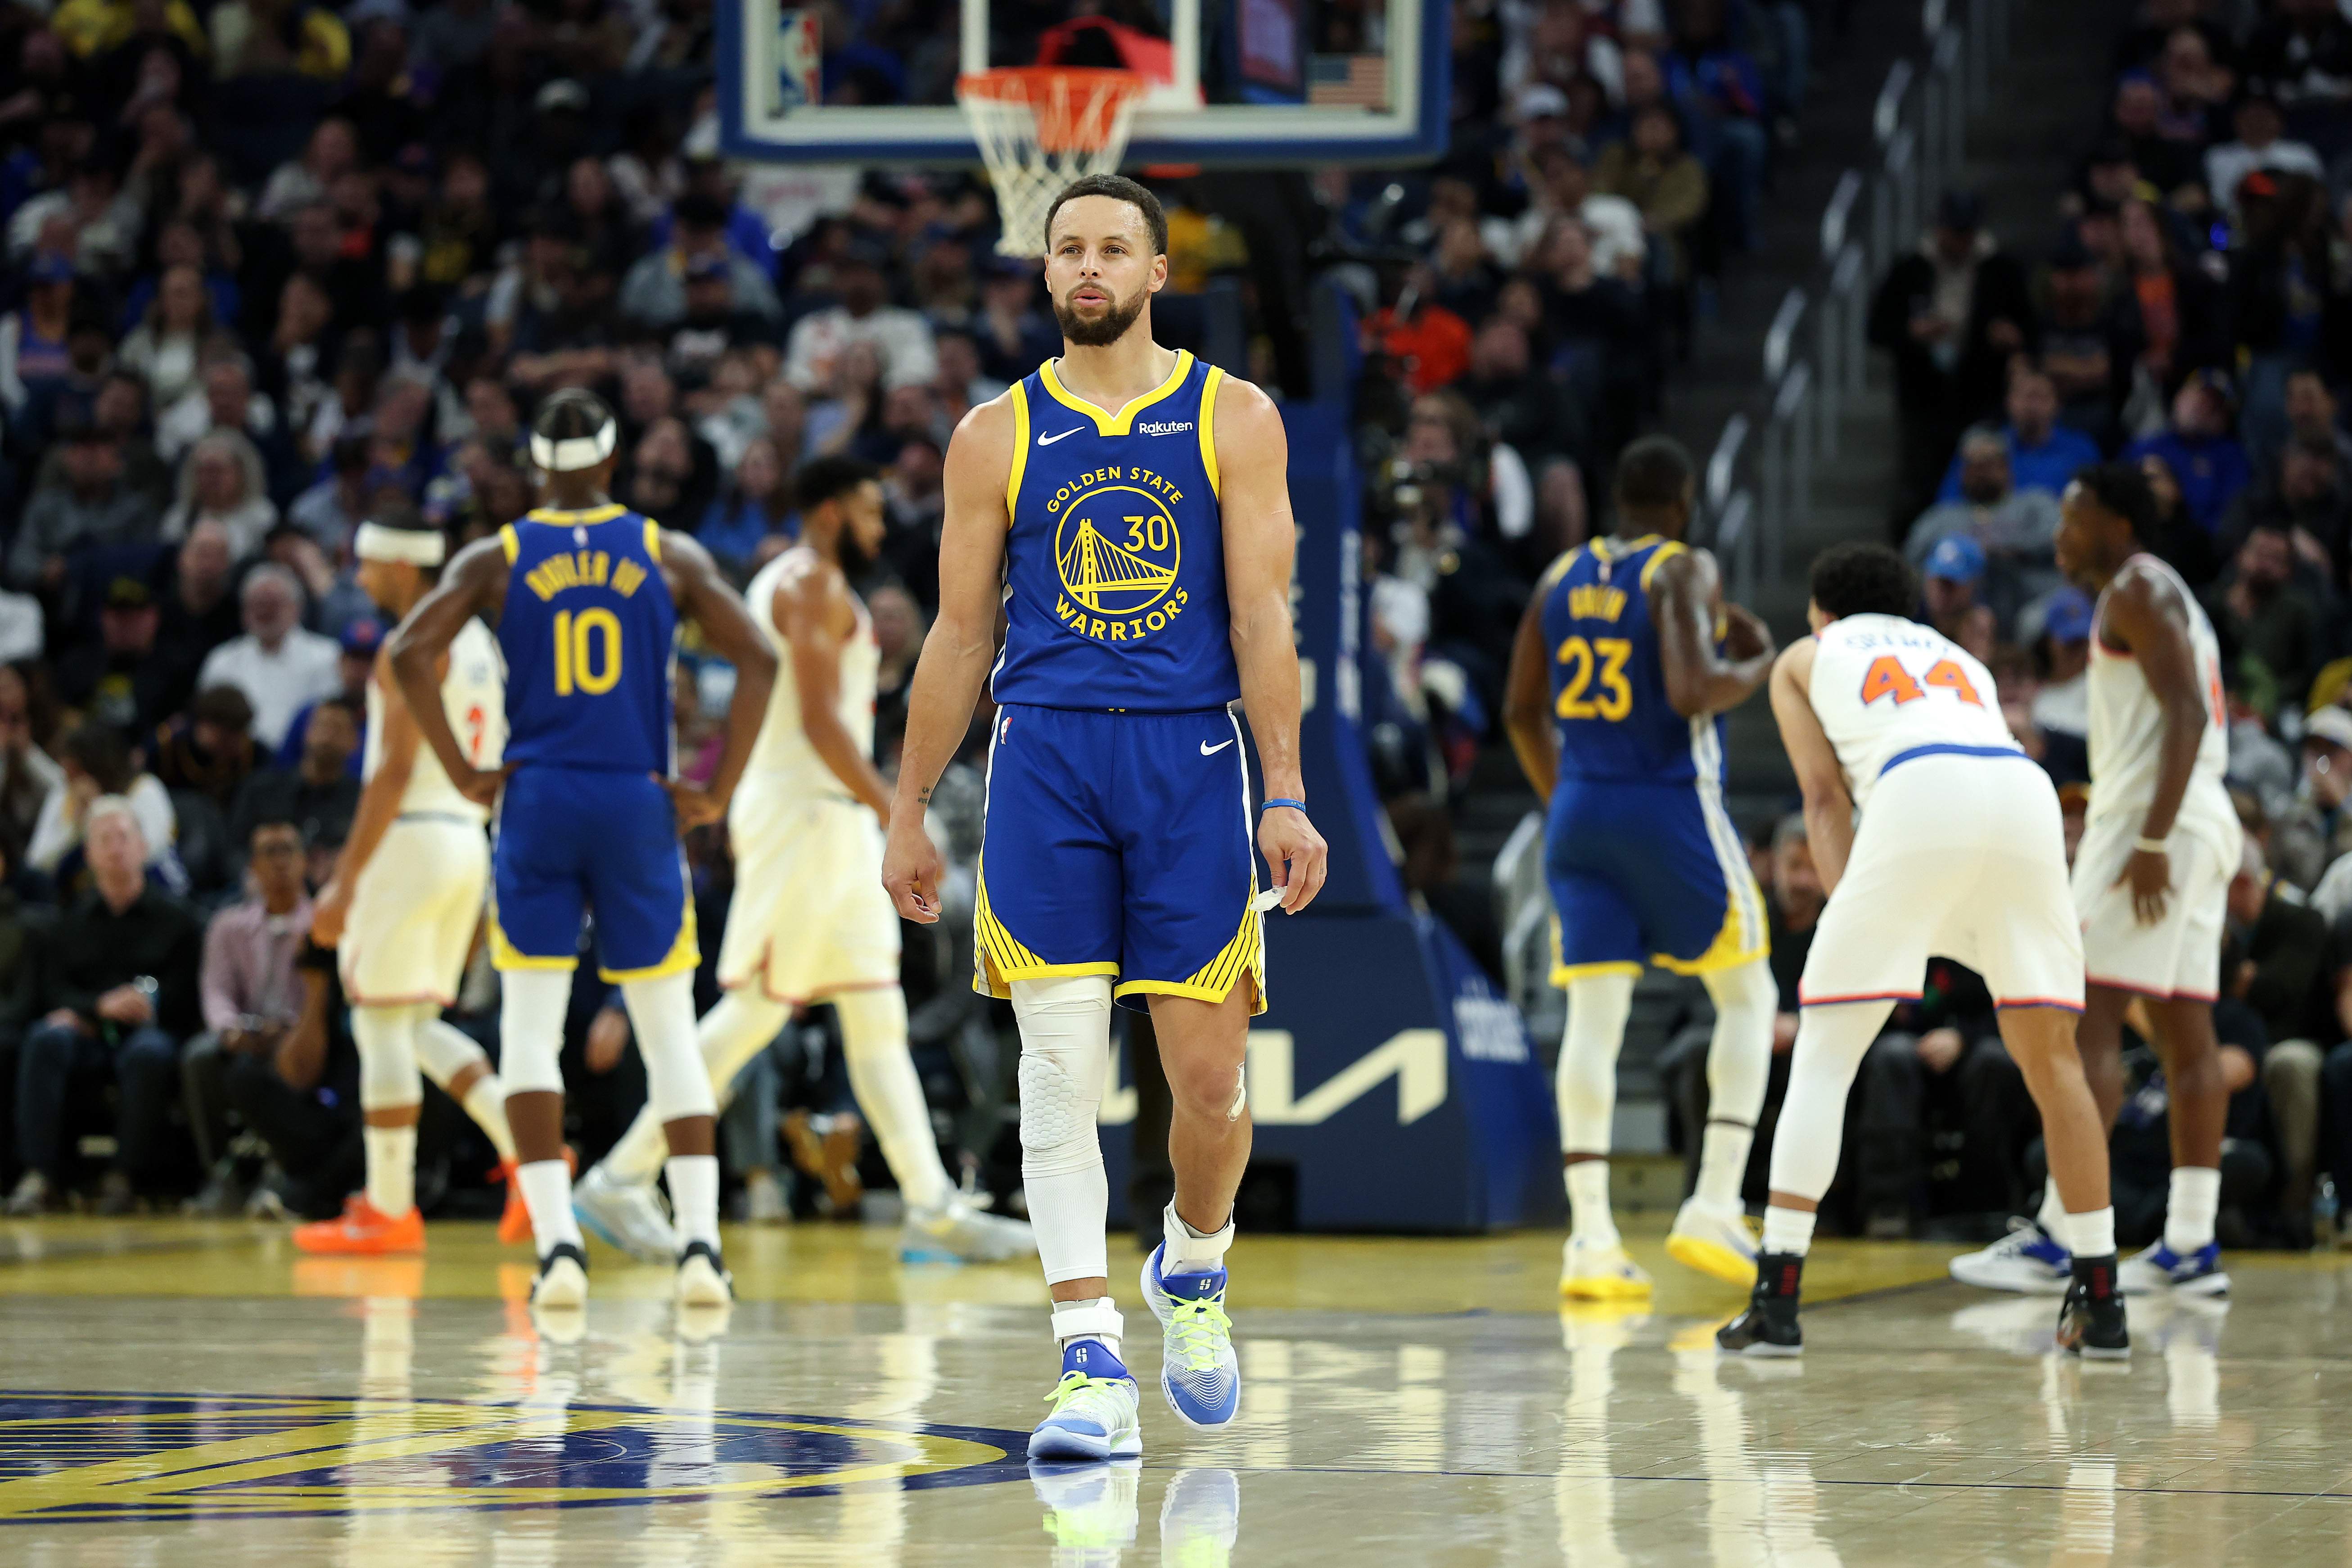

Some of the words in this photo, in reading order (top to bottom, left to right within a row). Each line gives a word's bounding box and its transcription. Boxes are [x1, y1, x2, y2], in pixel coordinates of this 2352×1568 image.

[1138, 421, 1193, 436] Rakuten
[1047, 465, 1121, 513] GOLDEN
[1129, 466, 1184, 505] STATE
[1123, 515, 1169, 551] 30
[1055, 586, 1188, 641] WARRIORS
[553, 606, 623, 697] 10
[1556, 635, 1633, 722] 23
[1861, 654, 1984, 708] 44
